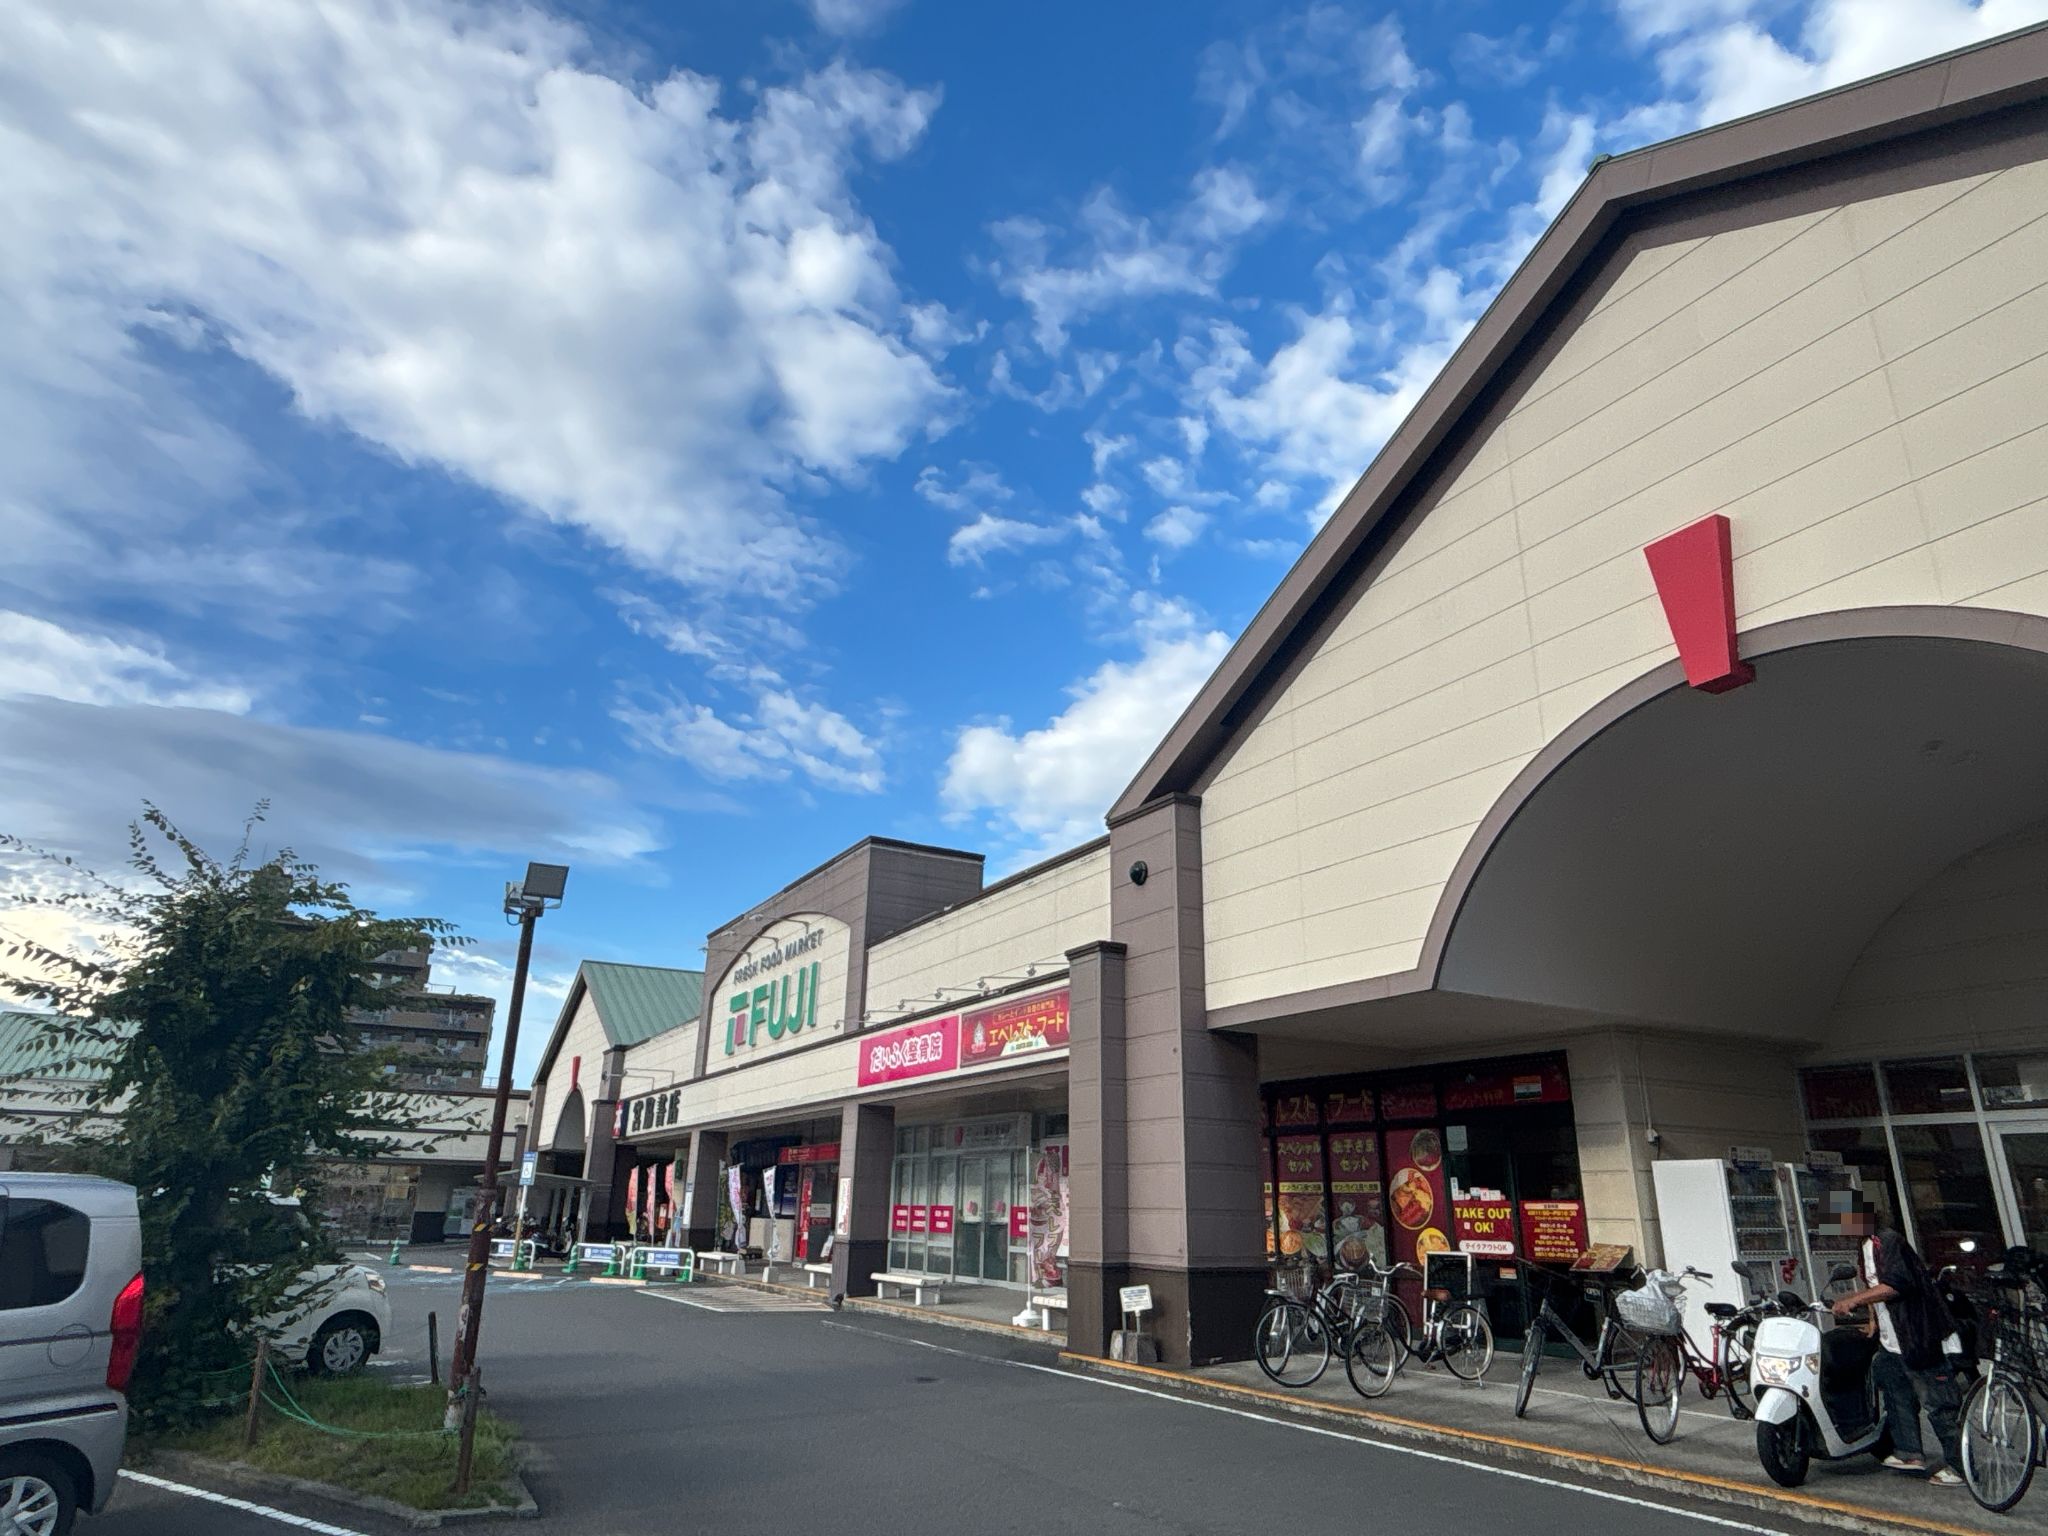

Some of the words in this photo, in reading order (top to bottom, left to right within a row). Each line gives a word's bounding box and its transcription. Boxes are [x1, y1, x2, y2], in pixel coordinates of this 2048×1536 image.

[733, 960, 759, 985] FRESH
[760, 948, 783, 972] FOOD
[784, 928, 824, 961] MARKET
[748, 961, 820, 1048] FUJI
[869, 1031, 943, 1074] だいふく整骨院
[1454, 1207, 1485, 1219] TAKE
[1487, 1207, 1512, 1219] OUT
[1474, 1221, 1495, 1233] OK!
[1465, 1242, 1507, 1251] テイクアウトOK
